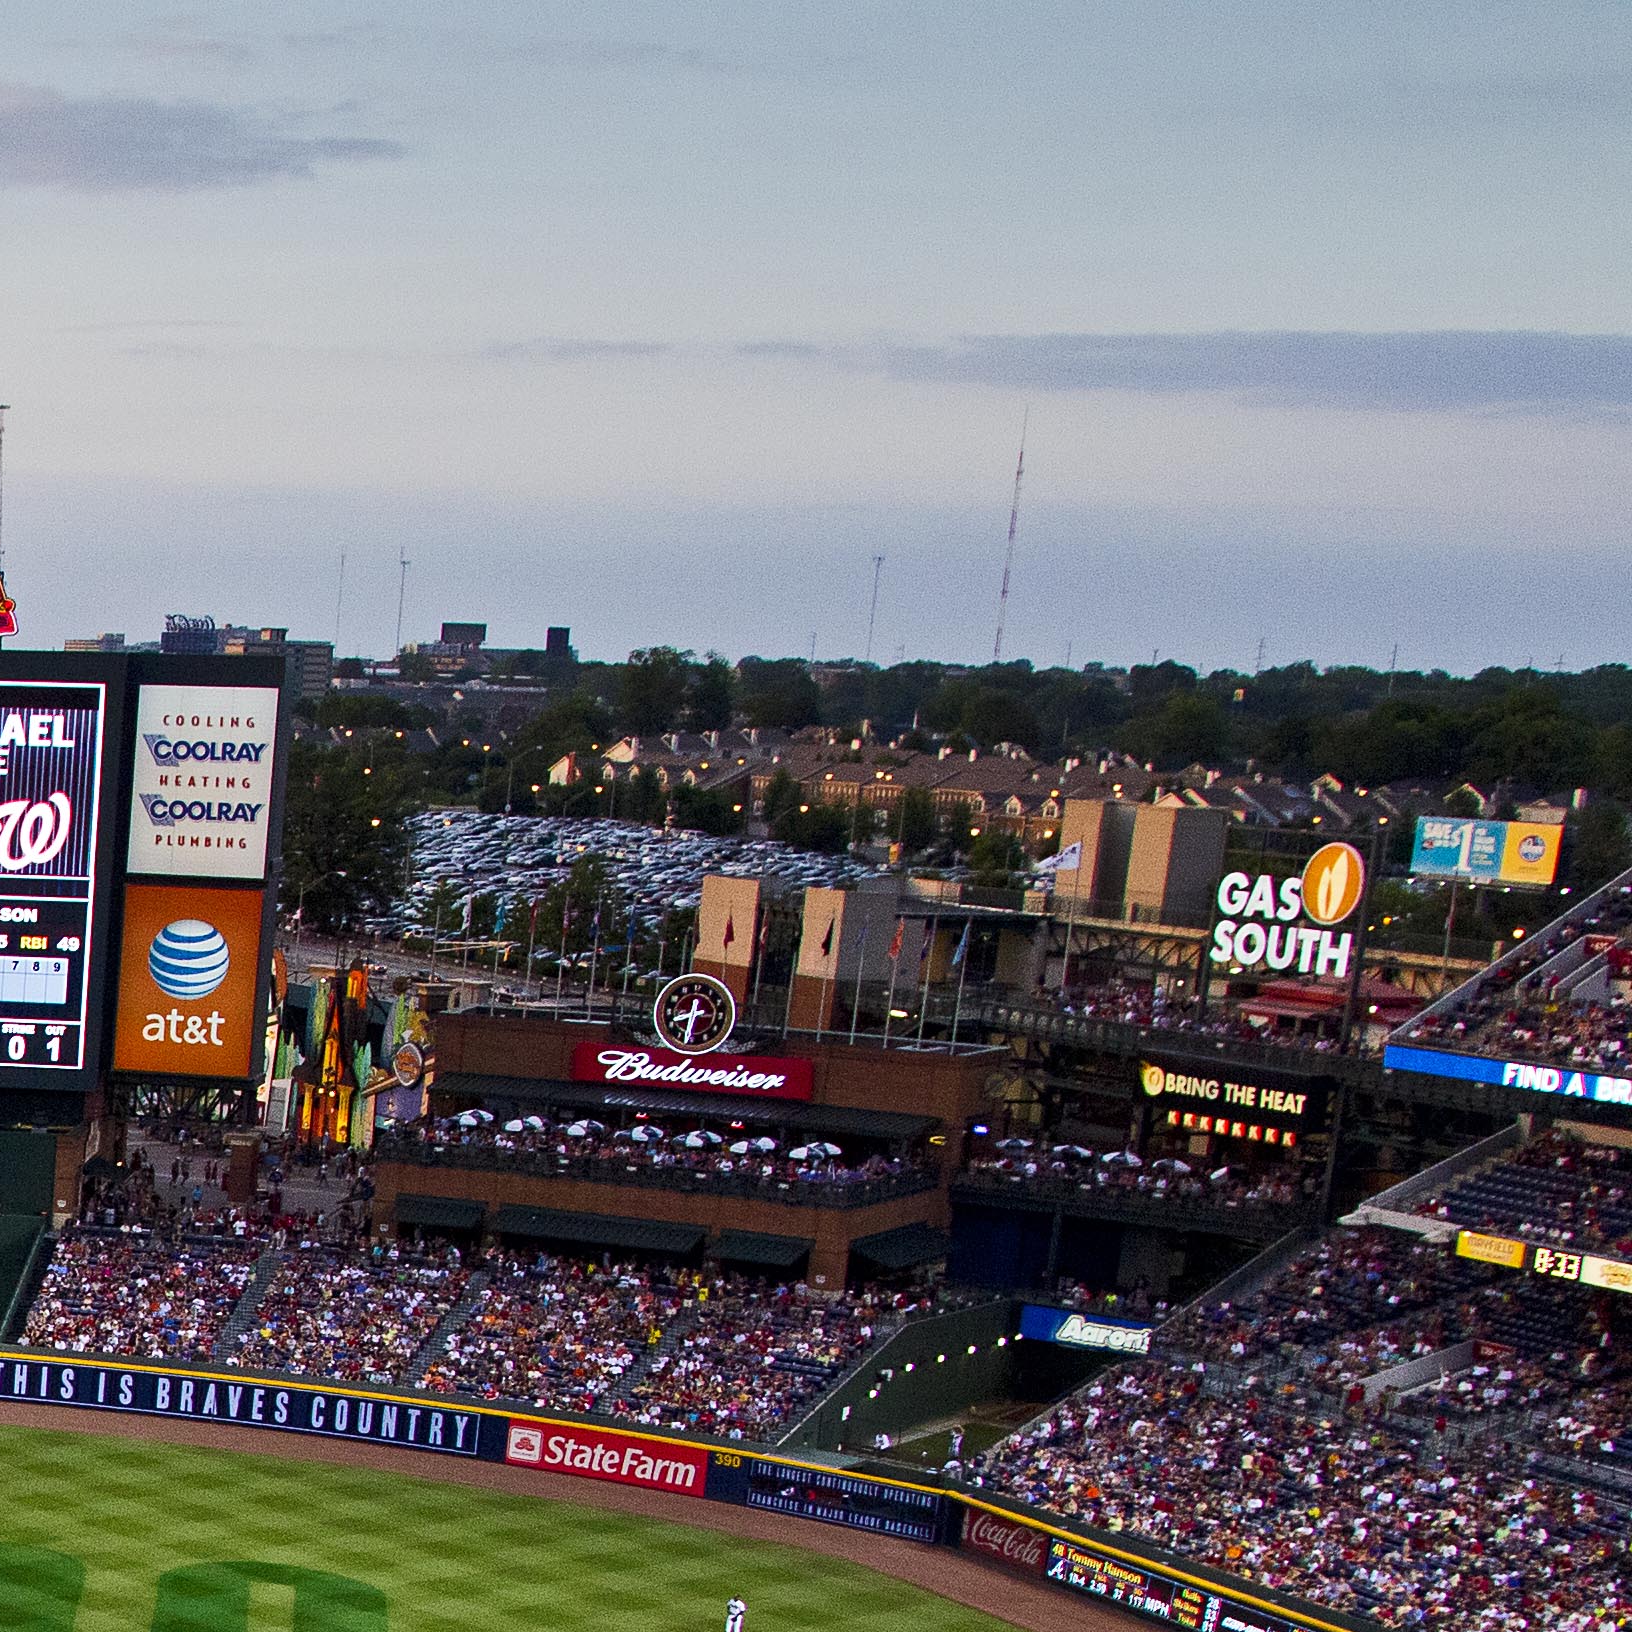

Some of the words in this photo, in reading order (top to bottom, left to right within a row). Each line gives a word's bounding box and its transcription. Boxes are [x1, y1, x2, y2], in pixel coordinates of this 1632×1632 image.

[163, 715, 255, 728] COOLING
[152, 740, 268, 763] COOLRAY
[160, 775, 251, 789] HEATING
[149, 799, 264, 823] COOLRAY
[155, 836, 247, 850] PLUMBING
[1218, 871, 1303, 921] GAS
[20, 936, 47, 950] RBI
[56, 937, 80, 951] 49
[1210, 919, 1353, 978] SOUTH
[12, 961, 19, 971] 7
[32, 962, 40, 971] 8
[54, 963, 61, 973] 9
[46, 1026, 67, 1035] OUT
[142, 1008, 226, 1046] at&t
[8, 1035, 25, 1060] 0
[46, 1037, 61, 1061] 1
[597, 1050, 786, 1090] Budweiser
[1503, 1062, 1562, 1093] FIND
[1565, 1071, 1586, 1097] A
[1165, 1073, 1220, 1100] BRING
[1223, 1082, 1256, 1107] THE
[1259, 1088, 1307, 1115] HEAT
[98, 1372, 133, 1405] IS
[157, 1376, 288, 1424] BRAVES
[311, 1395, 470, 1449] COUNTRY
[715, 1453, 740, 1469] 390
[815, 1503, 845, 1521] MAJOR
[847, 1510, 882, 1529] LEAGUE
[884, 1518, 932, 1539] BASEBALL
[971, 1512, 1043, 1567] Coca-Cola
[1067, 1548, 1103, 1572] Tommy
[1103, 1560, 1143, 1585] Hanson
[1144, 1597, 1170, 1619] MPH
